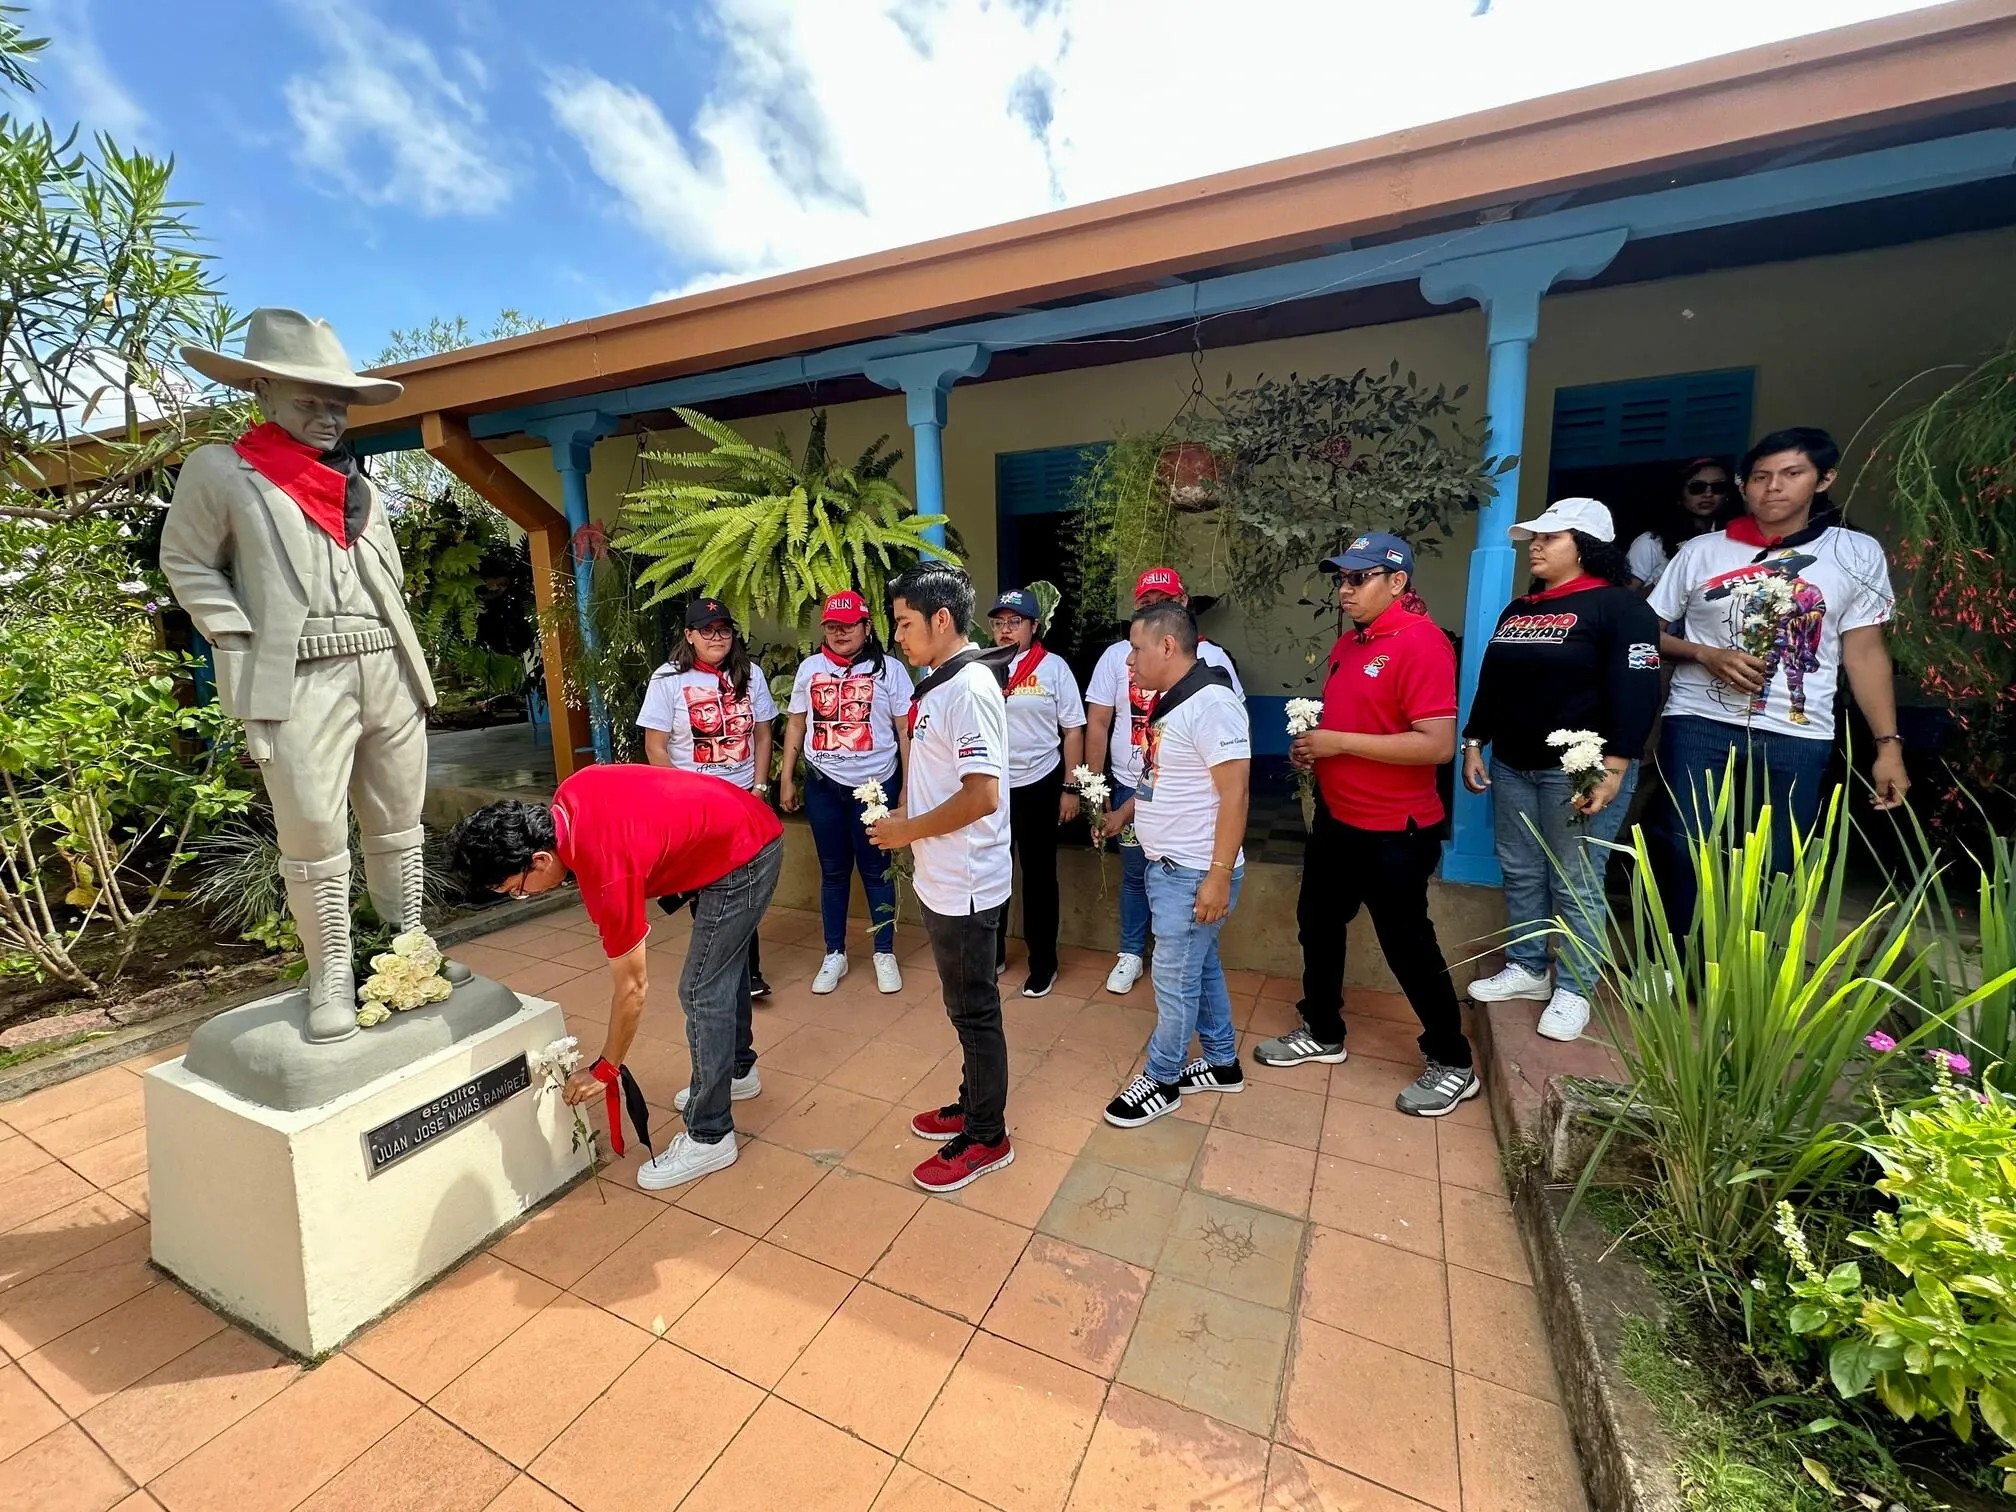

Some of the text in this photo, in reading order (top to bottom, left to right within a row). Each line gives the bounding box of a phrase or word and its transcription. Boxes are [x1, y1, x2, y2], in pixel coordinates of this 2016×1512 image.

[1722, 570, 1769, 590] FSLN
[376, 1073, 528, 1163] JUAN JOSÉ NAVAS RAMÍREZ
[422, 1080, 482, 1118] escultor
